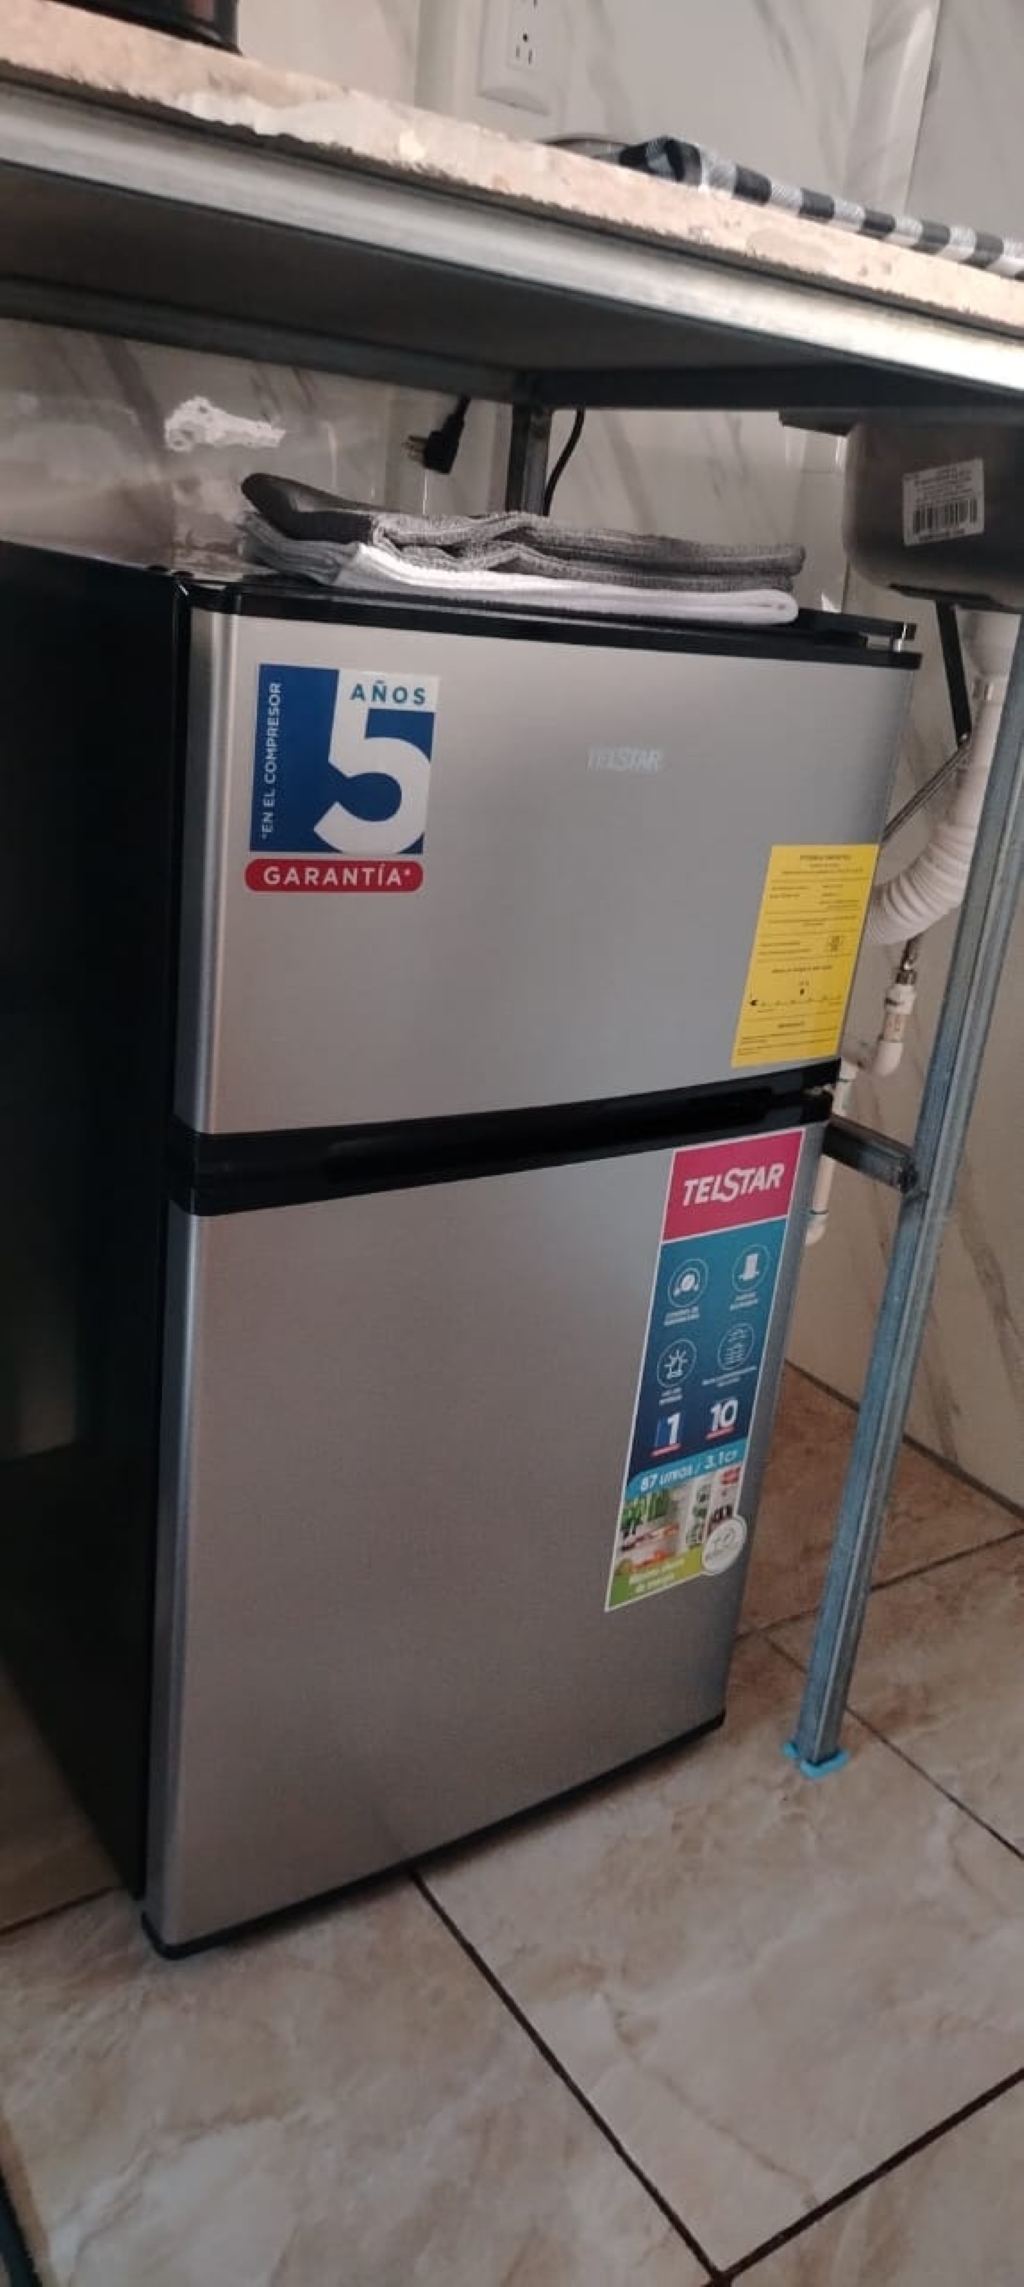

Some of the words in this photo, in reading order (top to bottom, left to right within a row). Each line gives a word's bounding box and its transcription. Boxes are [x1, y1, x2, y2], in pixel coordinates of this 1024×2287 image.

[349, 680, 426, 705] AÑOS
[264, 682, 282, 783] COMPRESOR
[314, 672, 431, 855] 5
[263, 790, 275, 808] EL
[682, 1162, 786, 1207] TELSTAR
[667, 1412, 681, 1446] 1
[710, 1399, 739, 1431] 10
[640, 1473, 659, 1492] 87
